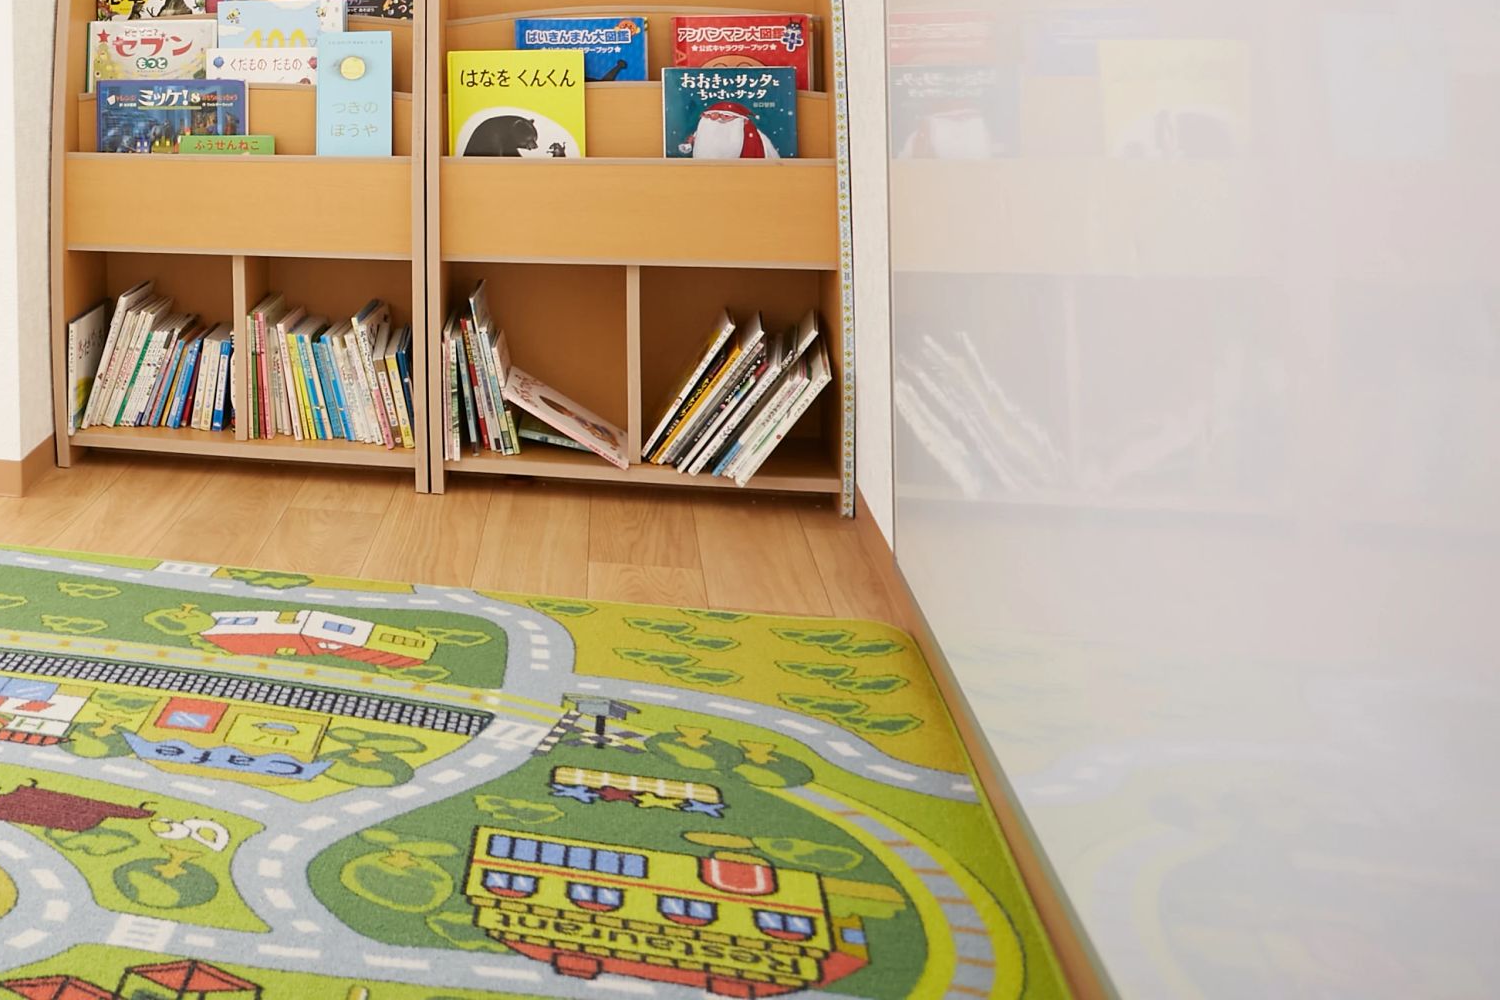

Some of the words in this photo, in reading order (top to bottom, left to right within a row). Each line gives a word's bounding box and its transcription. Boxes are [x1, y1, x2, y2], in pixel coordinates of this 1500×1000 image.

[112, 32, 193, 57] セブン
[525, 29, 631, 44] ばいきんまん大図鑑
[136, 58, 168, 69] もっと
[230, 58, 267, 71] くだもの
[273, 58, 302, 71] だもの
[460, 69, 511, 88] はなを
[518, 69, 576, 88] くんくん
[680, 72, 780, 89] おおきいサンタと
[138, 88, 189, 106] ミッケ!
[697, 89, 768, 100] ちいさいサンタ
[195, 140, 260, 150] ふうせんねこ
[154, 744, 304, 776] Cafe
[495, 910, 801, 976] Restaurant
